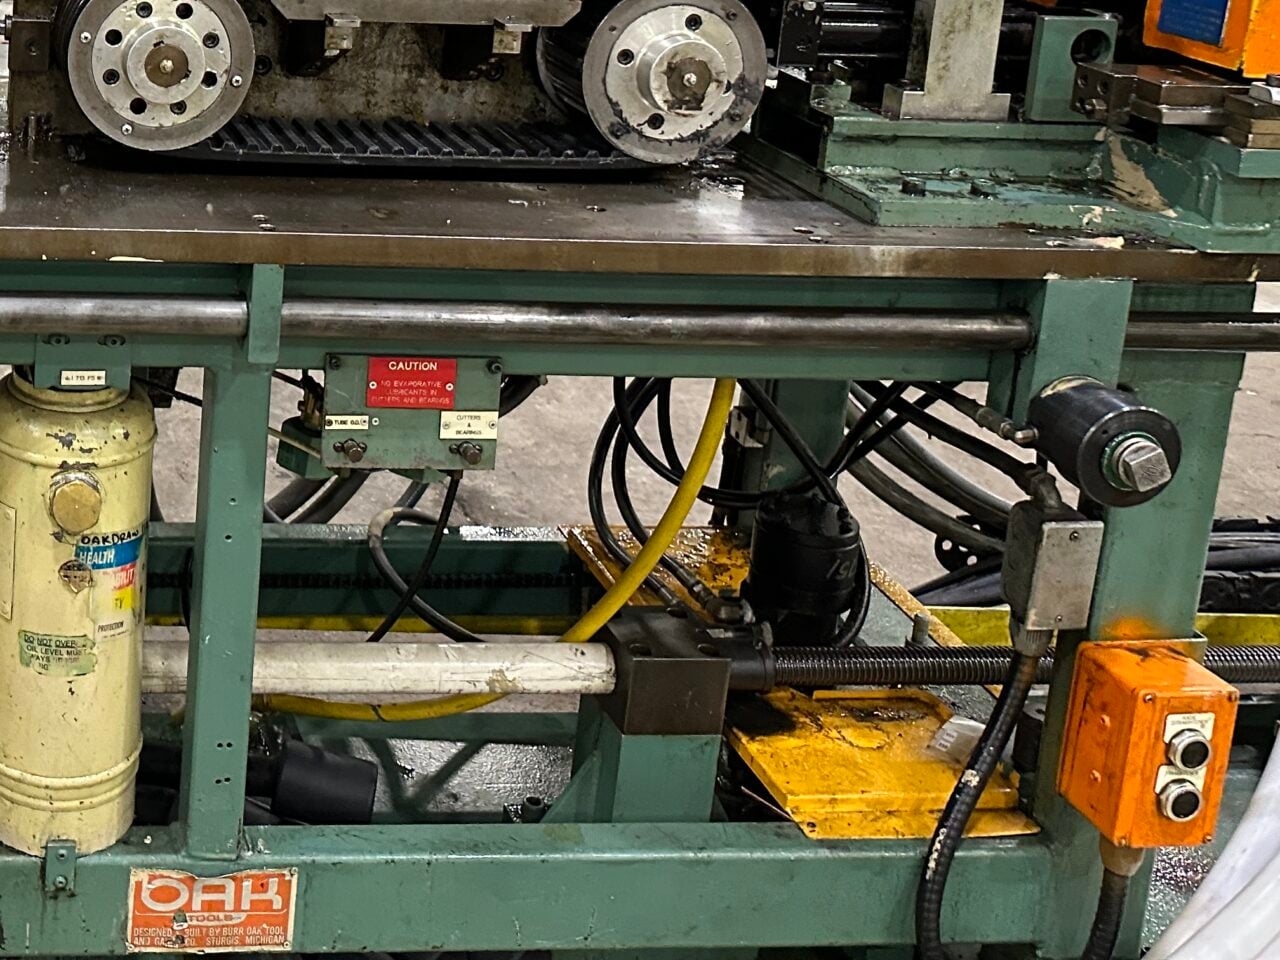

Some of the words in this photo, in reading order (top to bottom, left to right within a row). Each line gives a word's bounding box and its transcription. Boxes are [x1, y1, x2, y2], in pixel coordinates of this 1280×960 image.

[388, 361, 438, 371] CAUTION
[393, 380, 441, 388] EVAPORATIVE
[80, 529, 140, 545] OAKDRAW
[80, 548, 115, 564] HEALTH
[97, 621, 125, 633] PROTECTION
[23, 634, 35, 644] DO
[37, 637, 53, 648] NOT
[26, 644, 39, 653] OIL
[40, 647, 65, 656] LEVEL
[140, 876, 283, 912] OAK
[188, 914, 233, 922] TOOLS
[133, 927, 173, 937] DESIGNED
[209, 927, 221, 936] BY
[222, 927, 244, 936] BURR
[246, 927, 263, 935] OAK
[265, 926, 285, 935] TOOL
[245, 935, 285, 945] MICHIGAN
